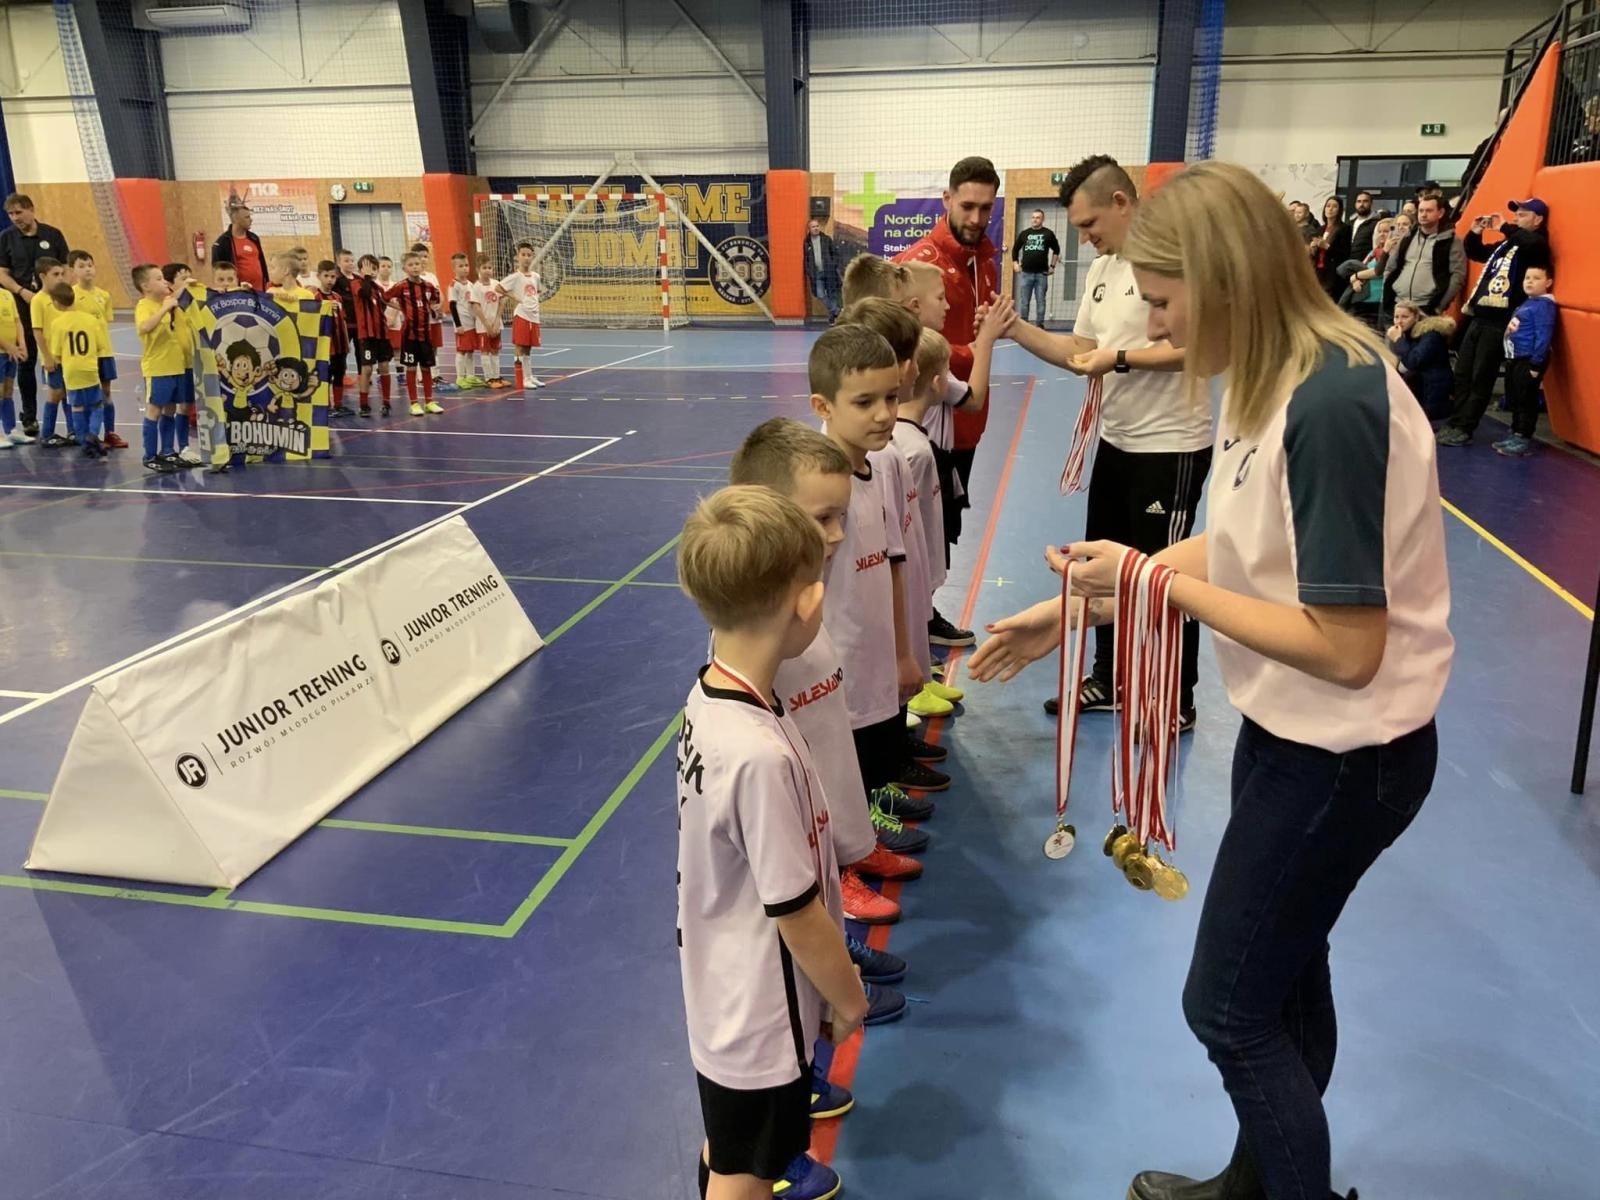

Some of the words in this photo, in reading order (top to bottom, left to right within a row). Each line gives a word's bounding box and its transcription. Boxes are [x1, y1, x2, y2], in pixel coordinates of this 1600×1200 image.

[249, 183, 279, 196] TKR
[884, 214, 932, 225] Nordic
[884, 229, 902, 238] na
[68, 330, 89, 356] 10
[364, 350, 372, 360] 8
[404, 352, 415, 363] 13
[230, 420, 305, 454] BOHUMÍN
[404, 603, 452, 642] JUNIOR
[448, 574, 499, 612] TRENING
[217, 698, 292, 754] JUNIOR
[288, 654, 368, 708] TRENING
[230, 736, 276, 769] ROZWÓJ
